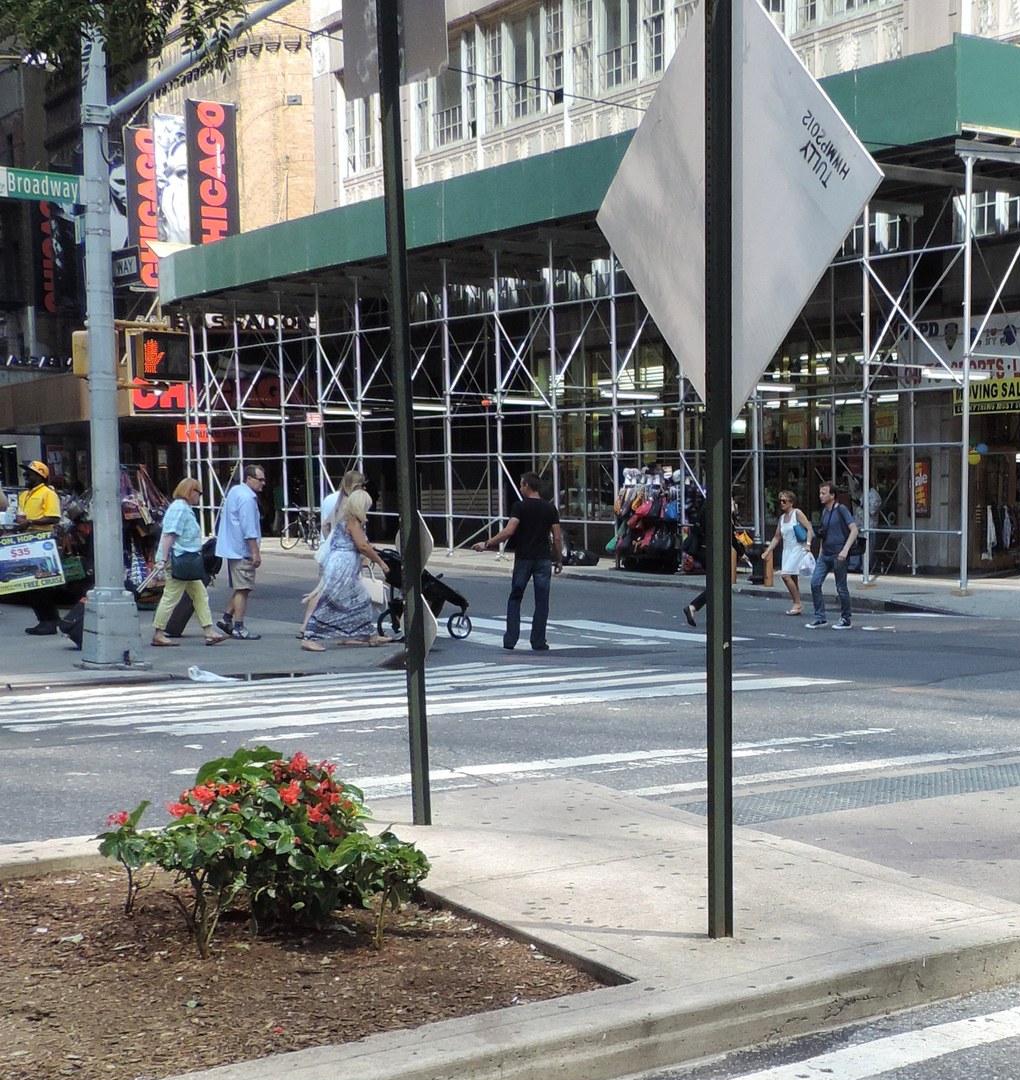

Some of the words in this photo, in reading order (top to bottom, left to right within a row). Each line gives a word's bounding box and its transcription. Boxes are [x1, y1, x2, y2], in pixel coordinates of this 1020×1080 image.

[197, 101, 228, 245] HICAGO
[799, 140, 832, 189] TULLY
[8, 172, 78, 204] Broadway
[117, 259, 135, 274] WAY
[955, 384, 997, 401] MVING
[11, 548, 30, 558] $35
[24, 581, 40, 589] FREE
[41, 576, 64, 586] CRUISE
